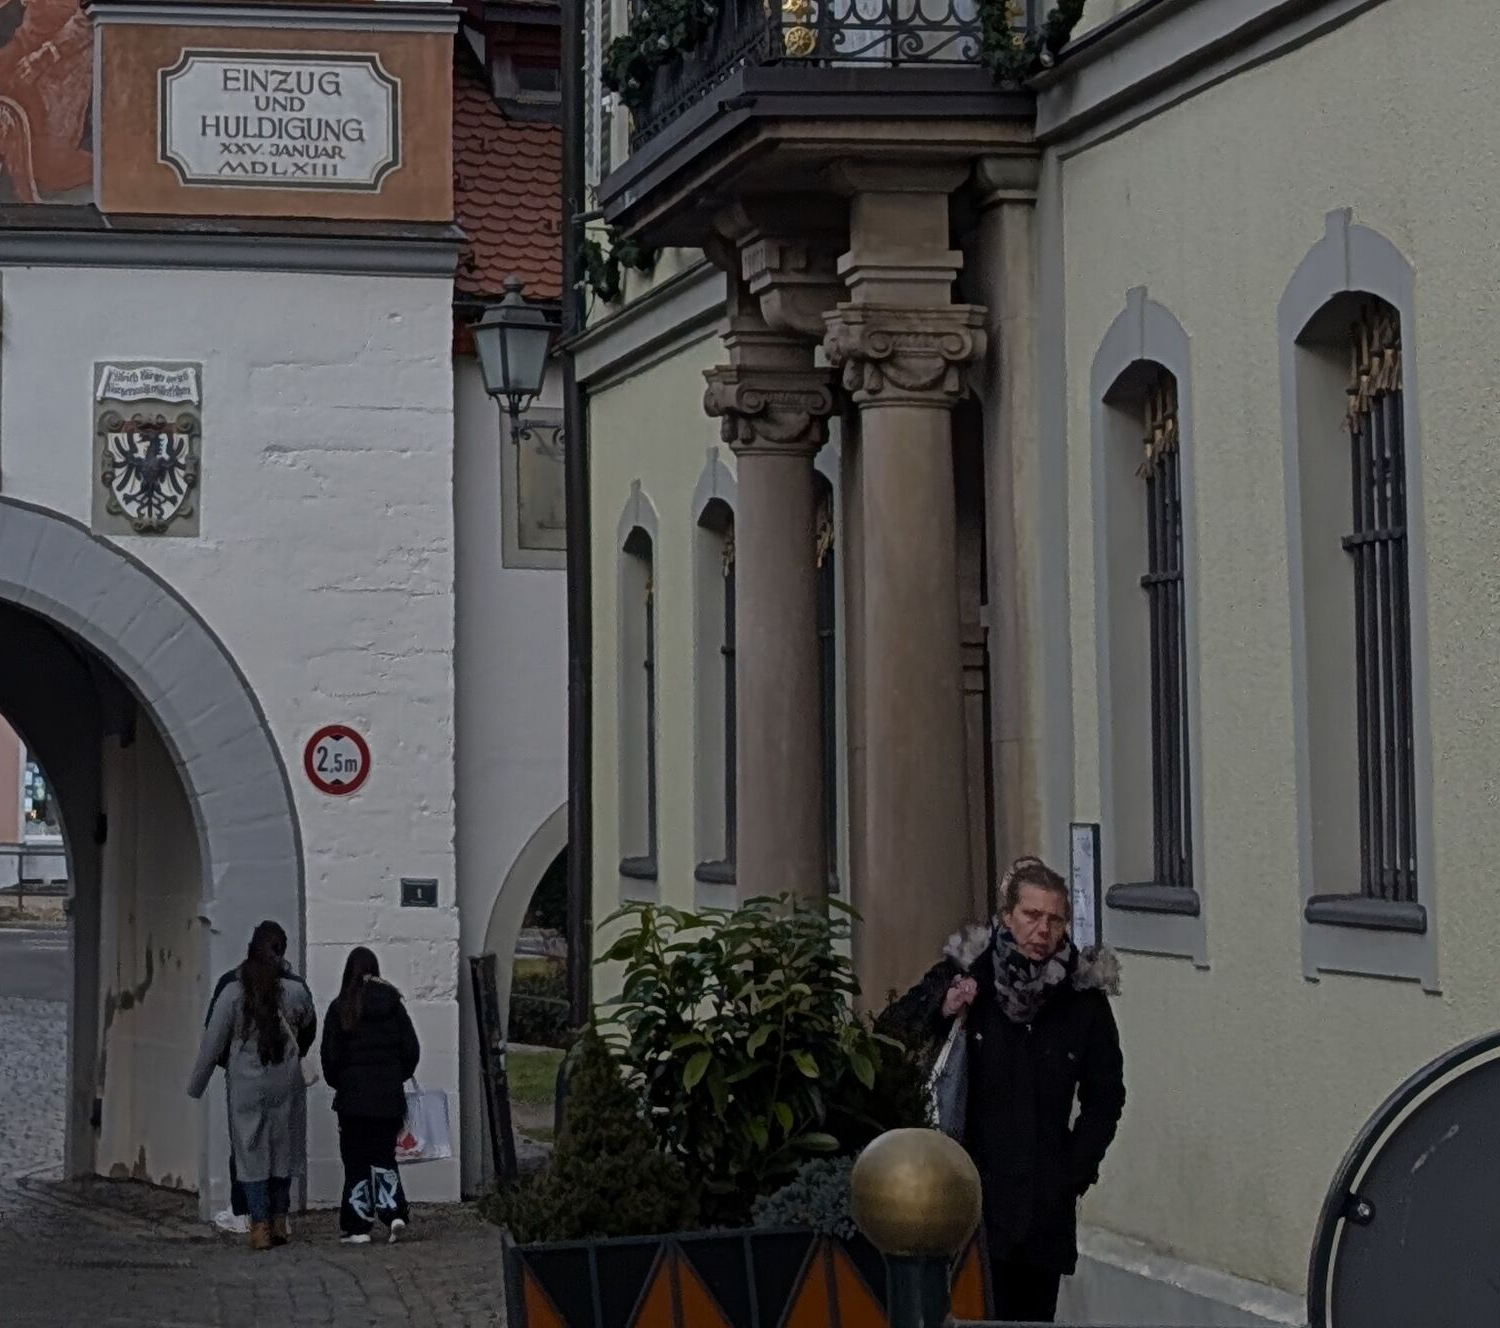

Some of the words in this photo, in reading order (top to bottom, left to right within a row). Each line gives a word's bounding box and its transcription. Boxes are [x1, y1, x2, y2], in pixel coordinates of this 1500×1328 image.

[222, 68, 342, 96] EINZUG
[254, 95, 306, 112] UND
[200, 115, 365, 143] HULDIGUNG
[269, 143, 346, 160] JANUAR
[218, 161, 339, 177] MDLXIII
